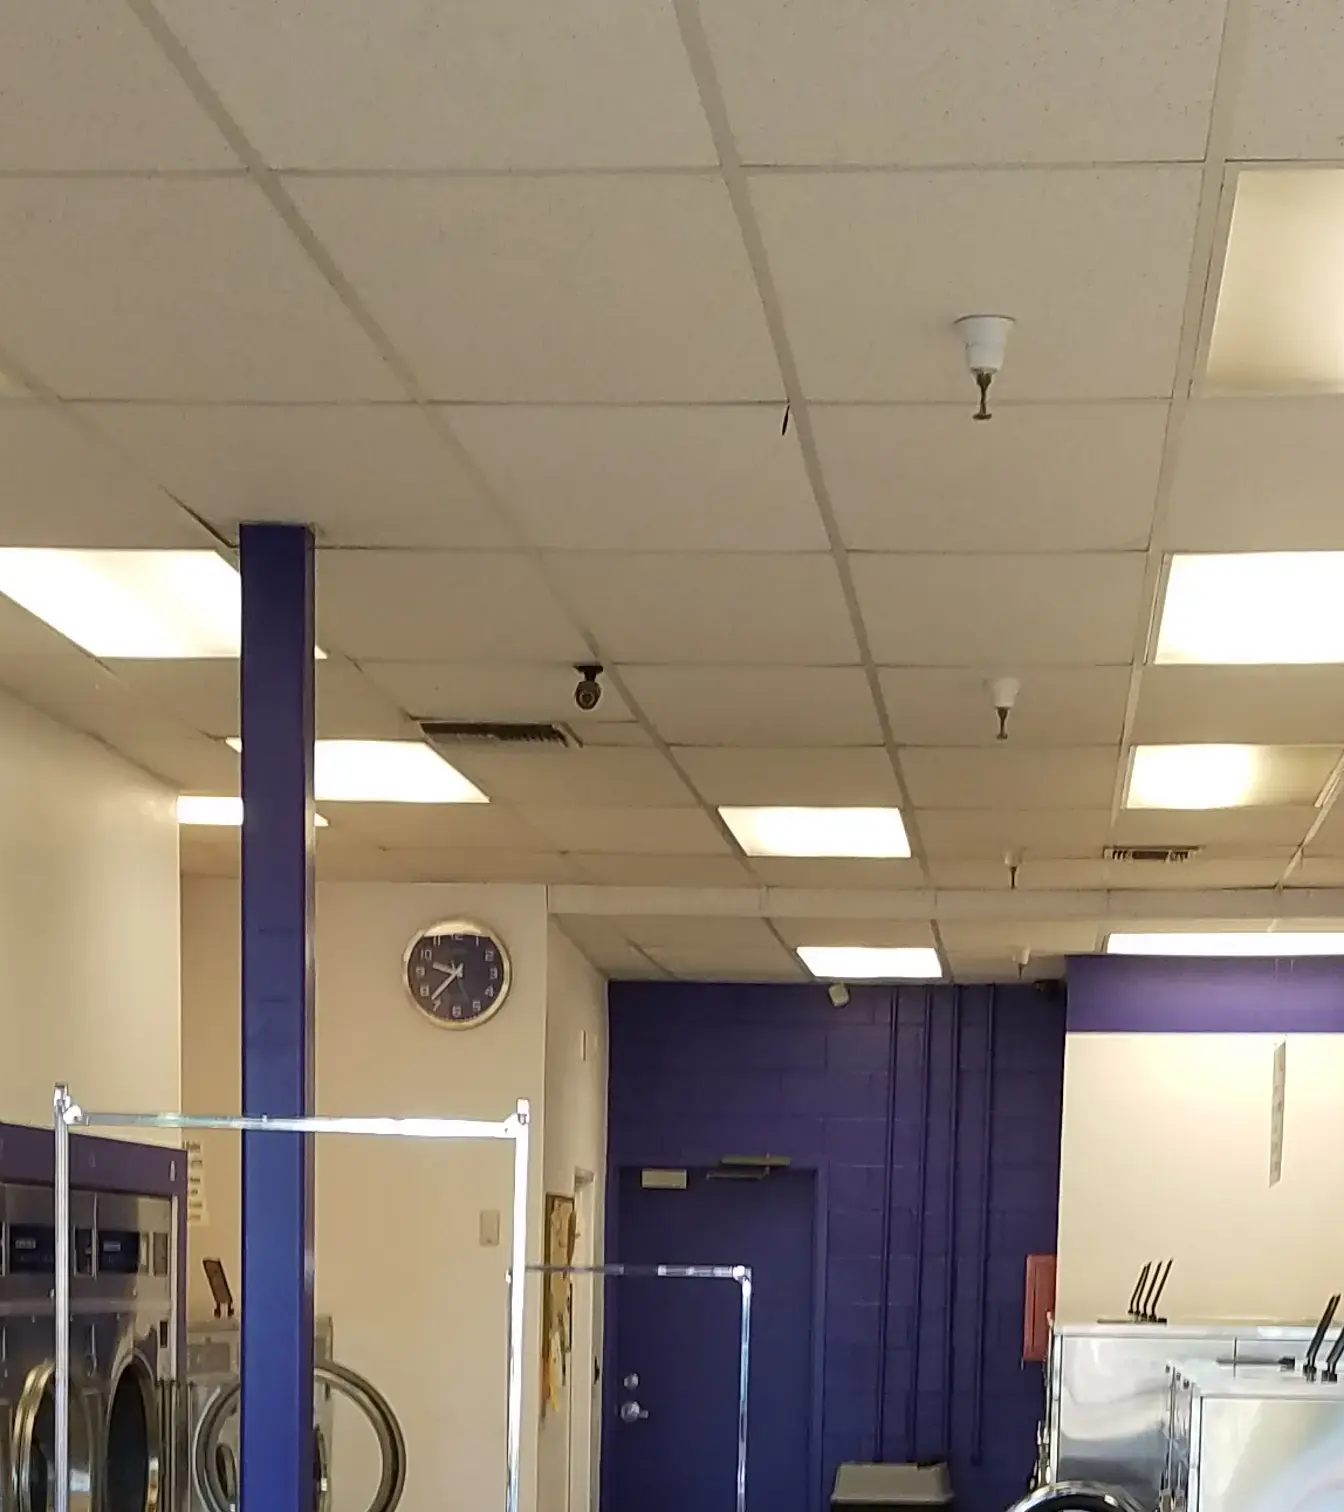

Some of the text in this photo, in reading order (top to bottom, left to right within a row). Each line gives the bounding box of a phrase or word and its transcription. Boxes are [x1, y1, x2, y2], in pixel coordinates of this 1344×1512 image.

[420, 949, 432, 961] 10
[484, 950, 494, 962] 2
[415, 966, 426, 977] 9
[490, 967, 498, 980] 3
[419, 985, 430, 997] 8
[484, 985, 494, 997] 4
[432, 1000, 442, 1012] 7
[451, 1005, 462, 1017] 6
[472, 1000, 482, 1012] 5
